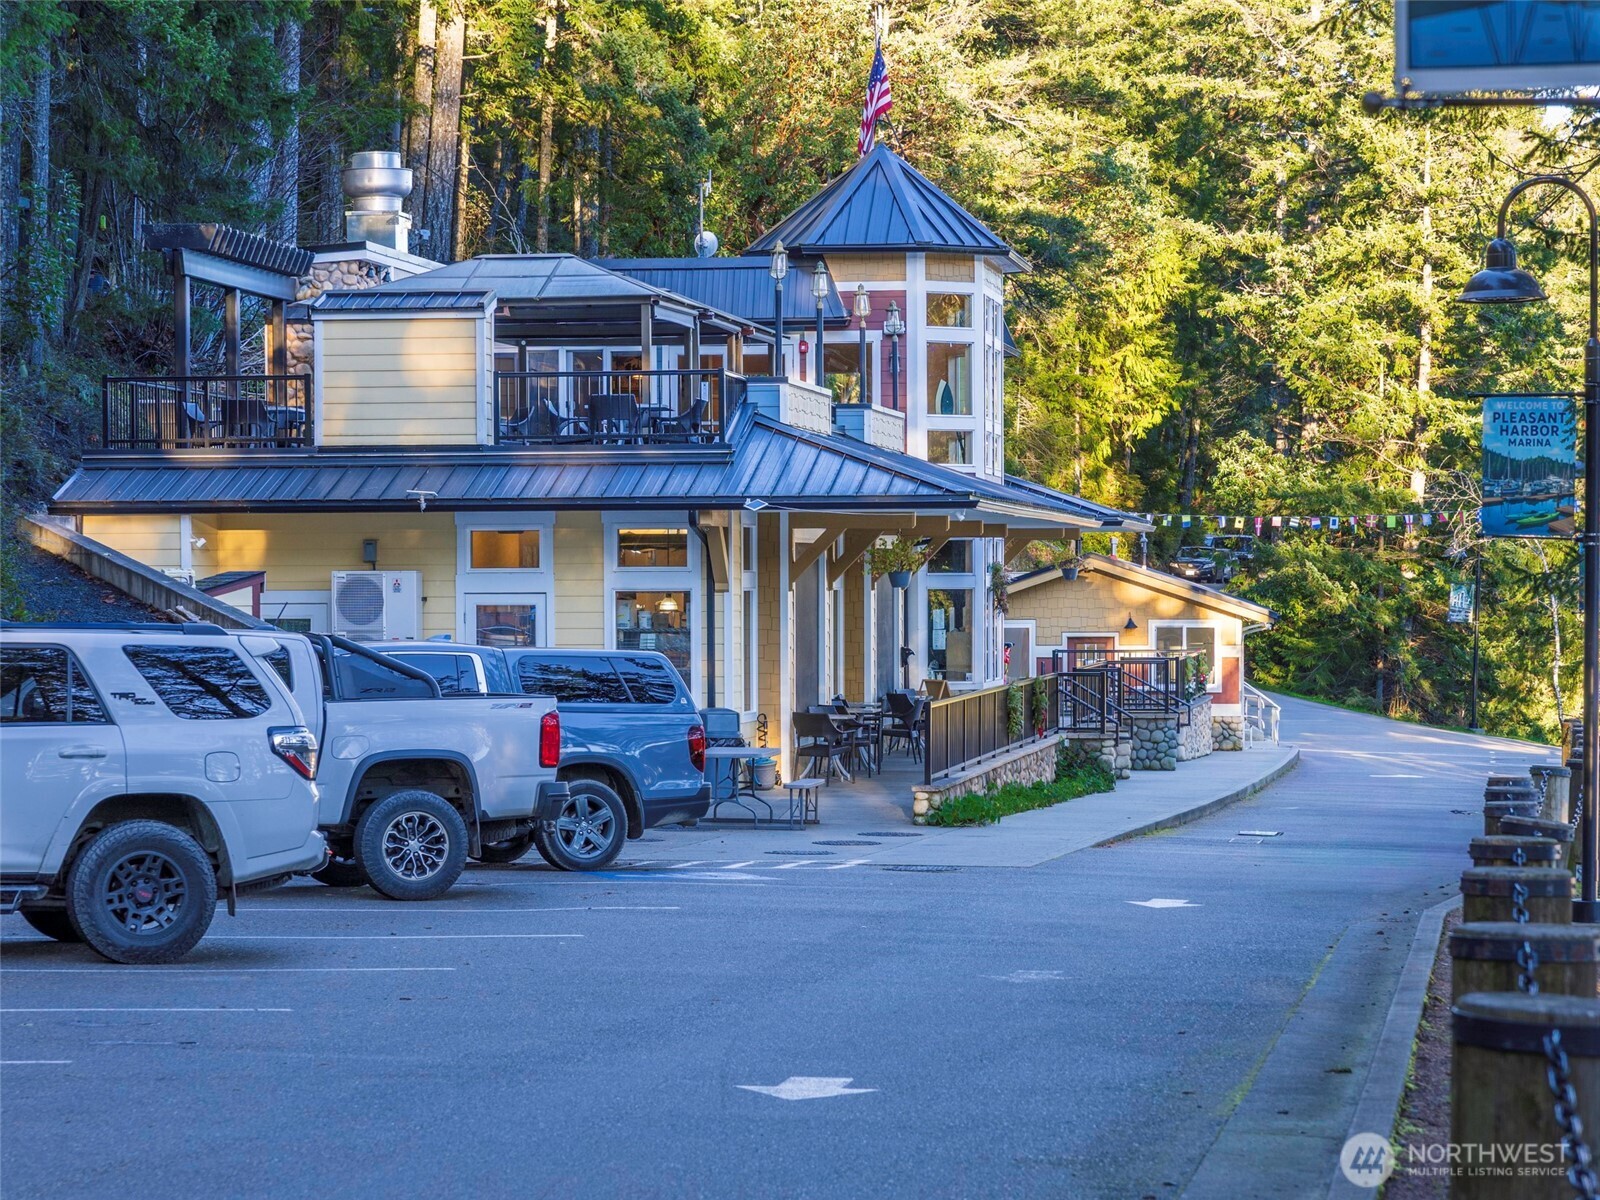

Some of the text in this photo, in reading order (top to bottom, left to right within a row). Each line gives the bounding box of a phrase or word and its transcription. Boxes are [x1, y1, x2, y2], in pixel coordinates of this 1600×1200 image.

[1497, 401, 1564, 410] WELCOME TO
[1492, 411, 1566, 423] PLEASANT
[1500, 424, 1559, 436] HARBOR
[1508, 438, 1552, 447] MARINA
[110, 692, 136, 700] TRD
